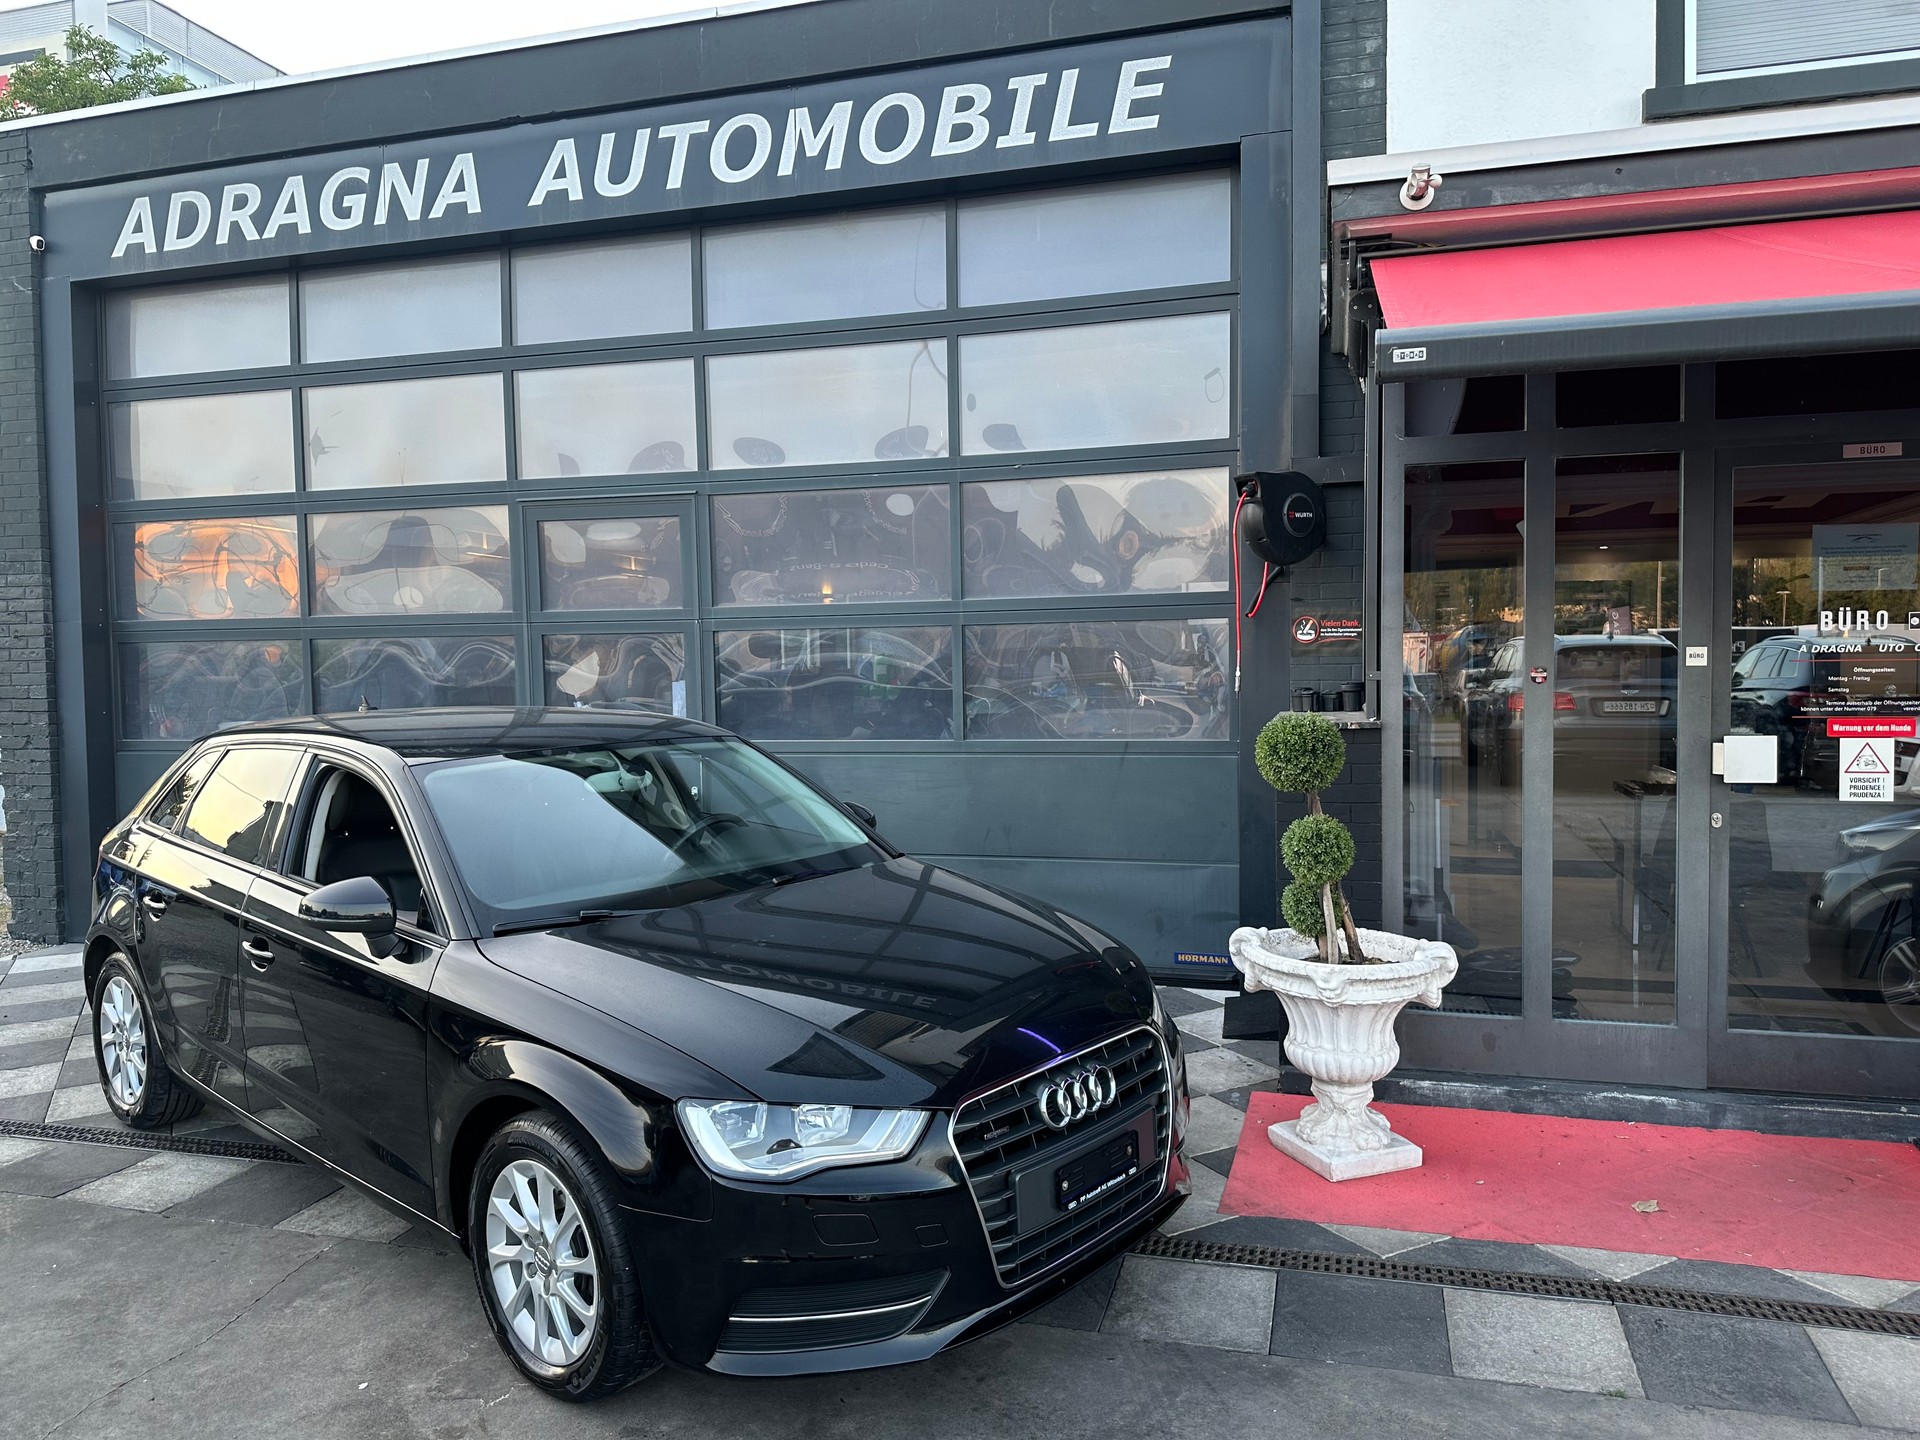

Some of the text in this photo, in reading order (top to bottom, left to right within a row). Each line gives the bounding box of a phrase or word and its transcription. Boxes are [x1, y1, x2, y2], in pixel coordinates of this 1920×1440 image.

[111, 54, 1173, 259] ADRAGNA AUTOMOBILE
[1860, 445, 1886, 454] BÜRO
[1820, 606, 1889, 631] BÜRO
[1853, 666, 1896, 674] Öffnungszeiten:
[1833, 724, 1861, 732] Warnung
